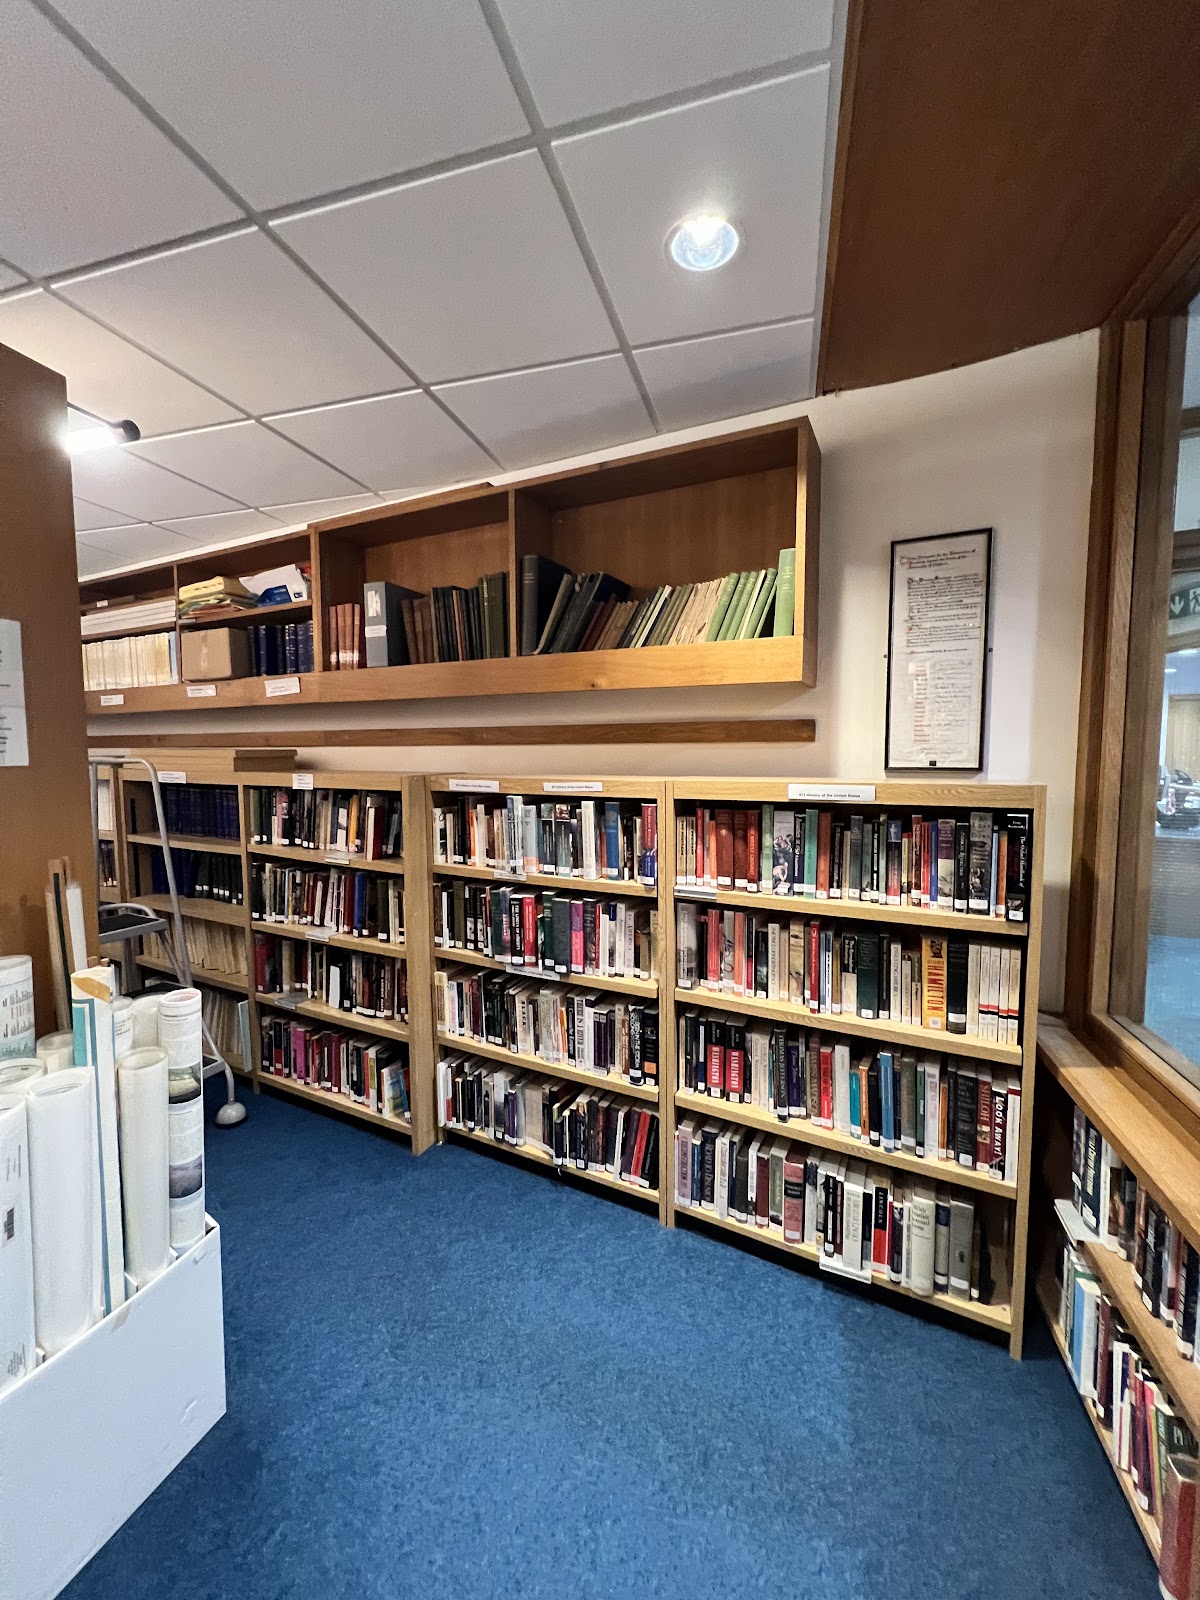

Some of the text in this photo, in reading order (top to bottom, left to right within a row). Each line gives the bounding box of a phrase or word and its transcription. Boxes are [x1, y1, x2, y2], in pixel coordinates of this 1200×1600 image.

[927, 965, 944, 1011] HAMILTON
[712, 1047, 720, 1083] WASHINGTON
[731, 1051, 739, 1089] WASHINGTON
[810, 1052, 819, 1114] JAMES MADISON
[980, 1084, 989, 1121] SHILOH
[994, 1096, 1005, 1156] LOOK AWAY!
